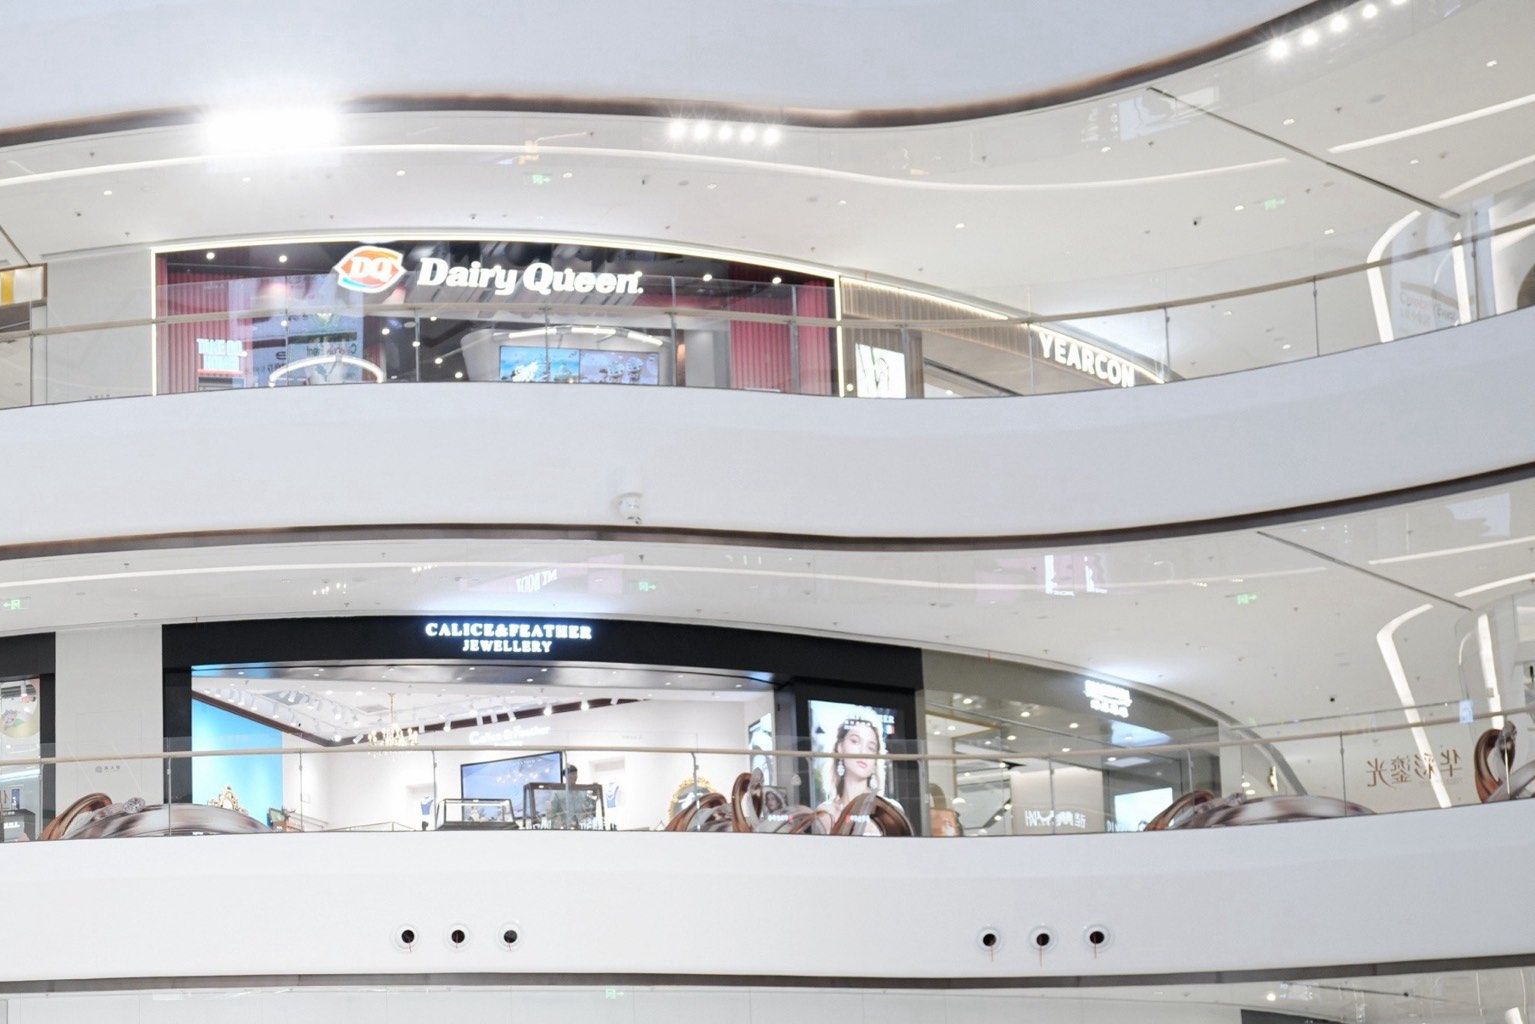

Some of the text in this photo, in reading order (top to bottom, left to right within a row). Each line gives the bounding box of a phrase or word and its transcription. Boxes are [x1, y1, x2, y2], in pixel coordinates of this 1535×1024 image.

[350, 255, 392, 283] DQ
[417, 257, 517, 295] Dairy
[1038, 332, 1135, 387] YEARCON
[425, 622, 593, 640] CALICE&FEATHER
[462, 639, 553, 653] JEWELLERY
